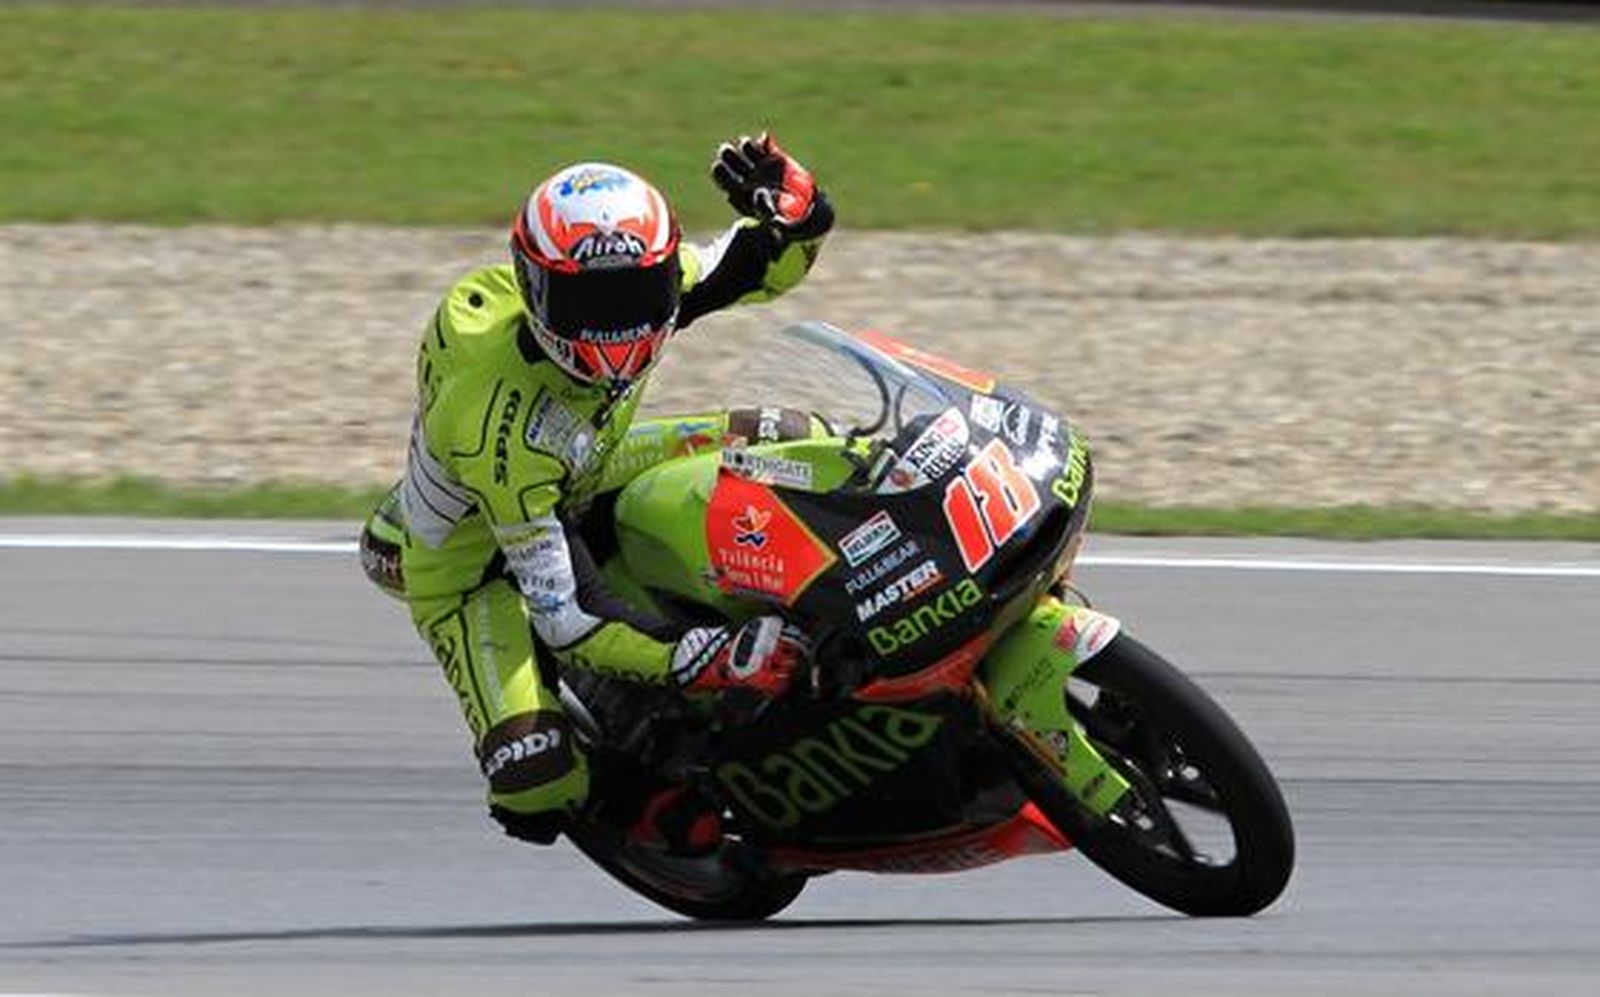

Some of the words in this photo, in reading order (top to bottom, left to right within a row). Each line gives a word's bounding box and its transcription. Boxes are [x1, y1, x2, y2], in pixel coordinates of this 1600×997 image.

[574, 233, 643, 260] Airoh
[942, 438, 1041, 574] 18
[856, 560, 938, 622] MASTER
[867, 578, 983, 656] Bankia
[716, 704, 942, 828] Bankia
